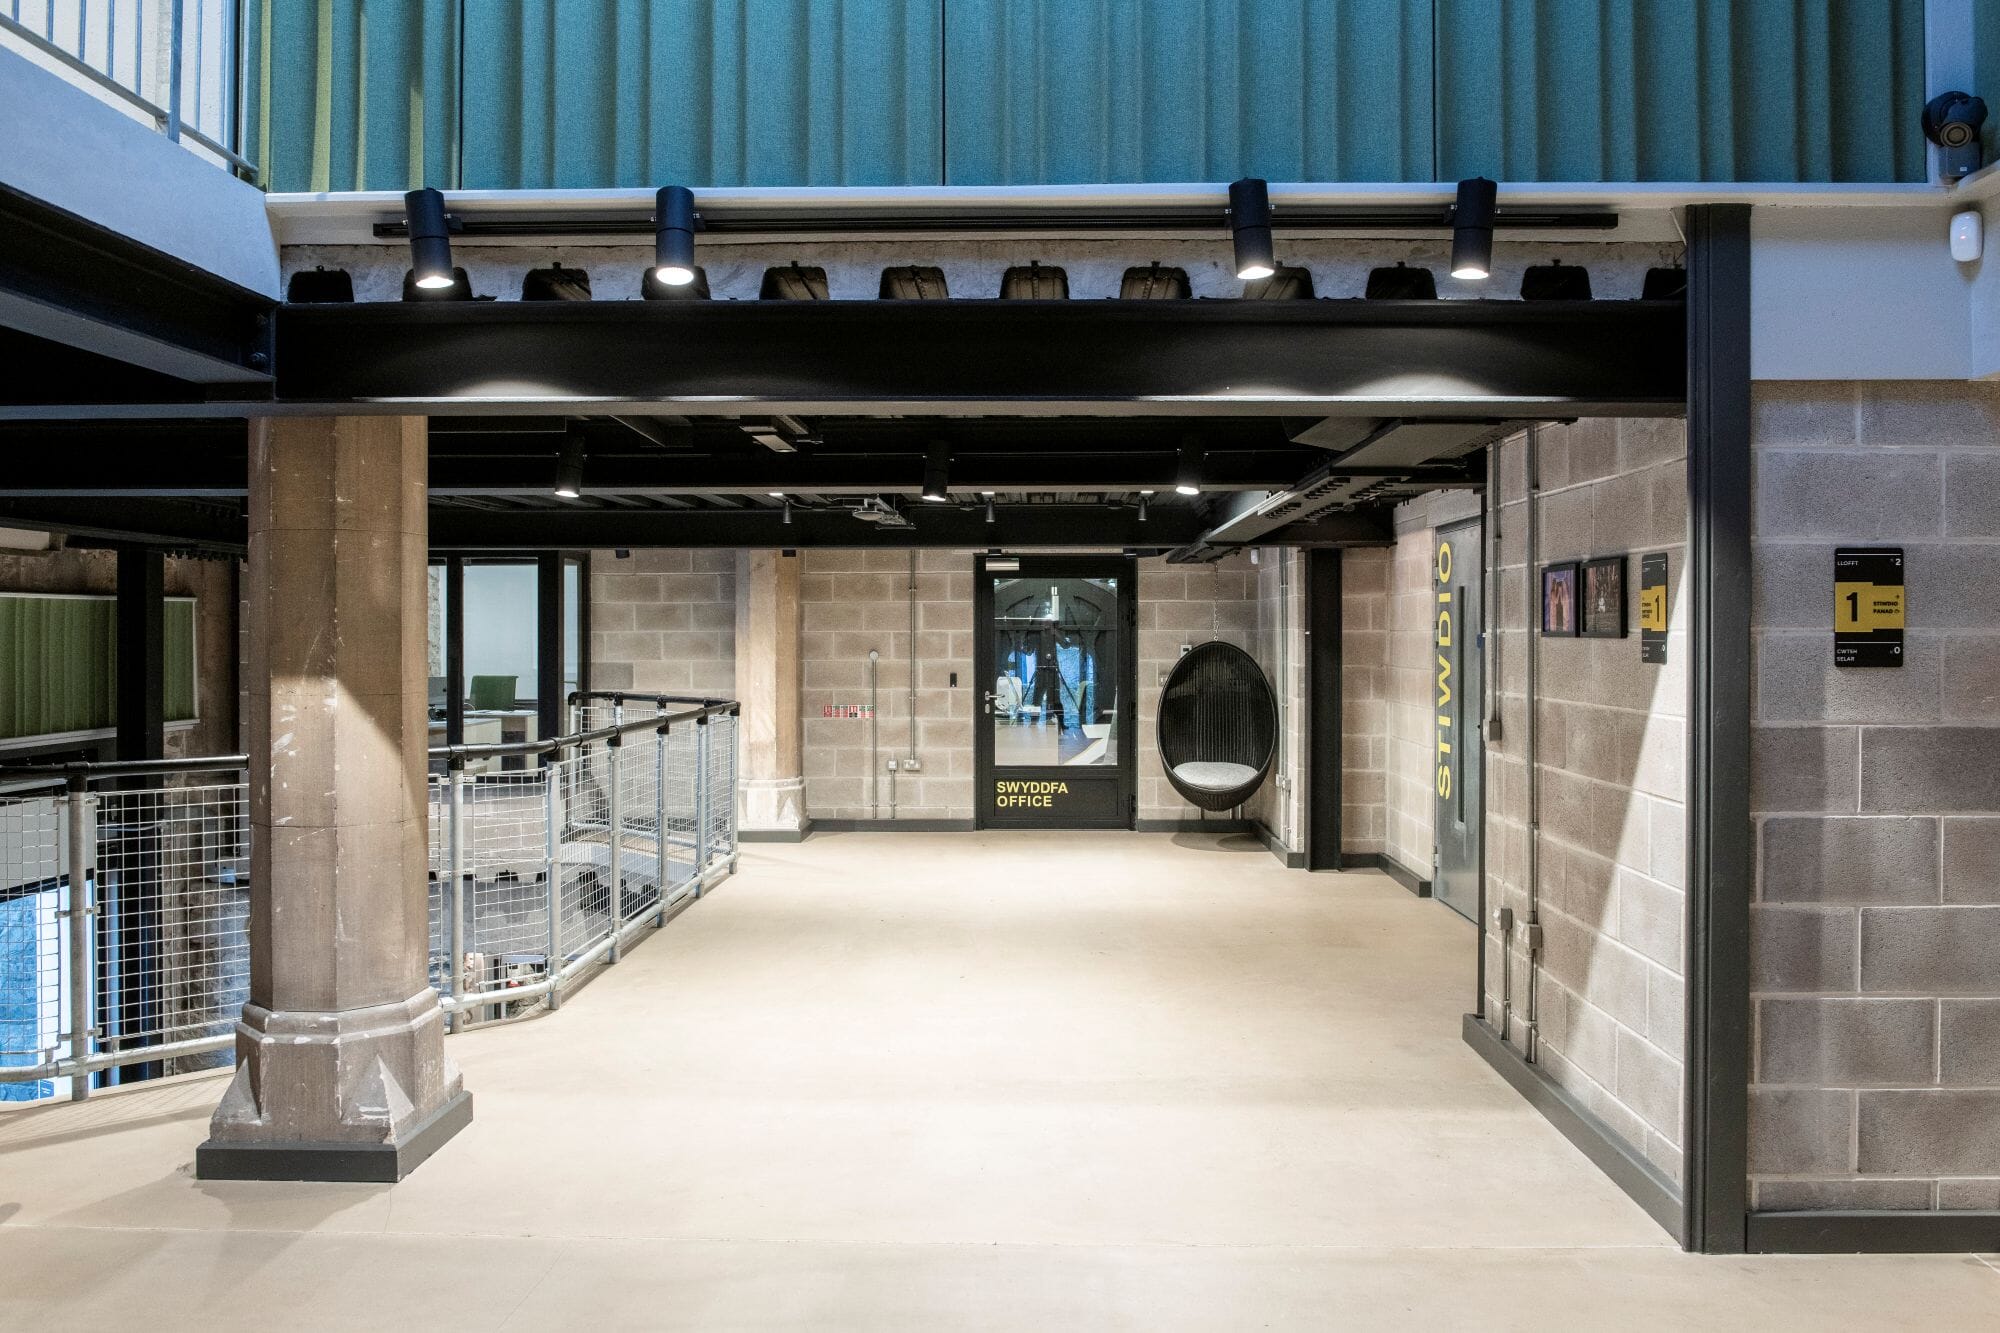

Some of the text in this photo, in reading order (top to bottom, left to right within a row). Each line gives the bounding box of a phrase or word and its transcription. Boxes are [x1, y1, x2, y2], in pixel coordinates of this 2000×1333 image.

[1895, 558, 1902, 566] 2
[1654, 594, 1660, 622] 1
[1846, 591, 1858, 622] 1
[1894, 646, 1901, 654] 0
[1437, 542, 1452, 800] STIWDIO
[996, 781, 1069, 794] SWYDDFA
[996, 795, 1053, 807] OFFICE
